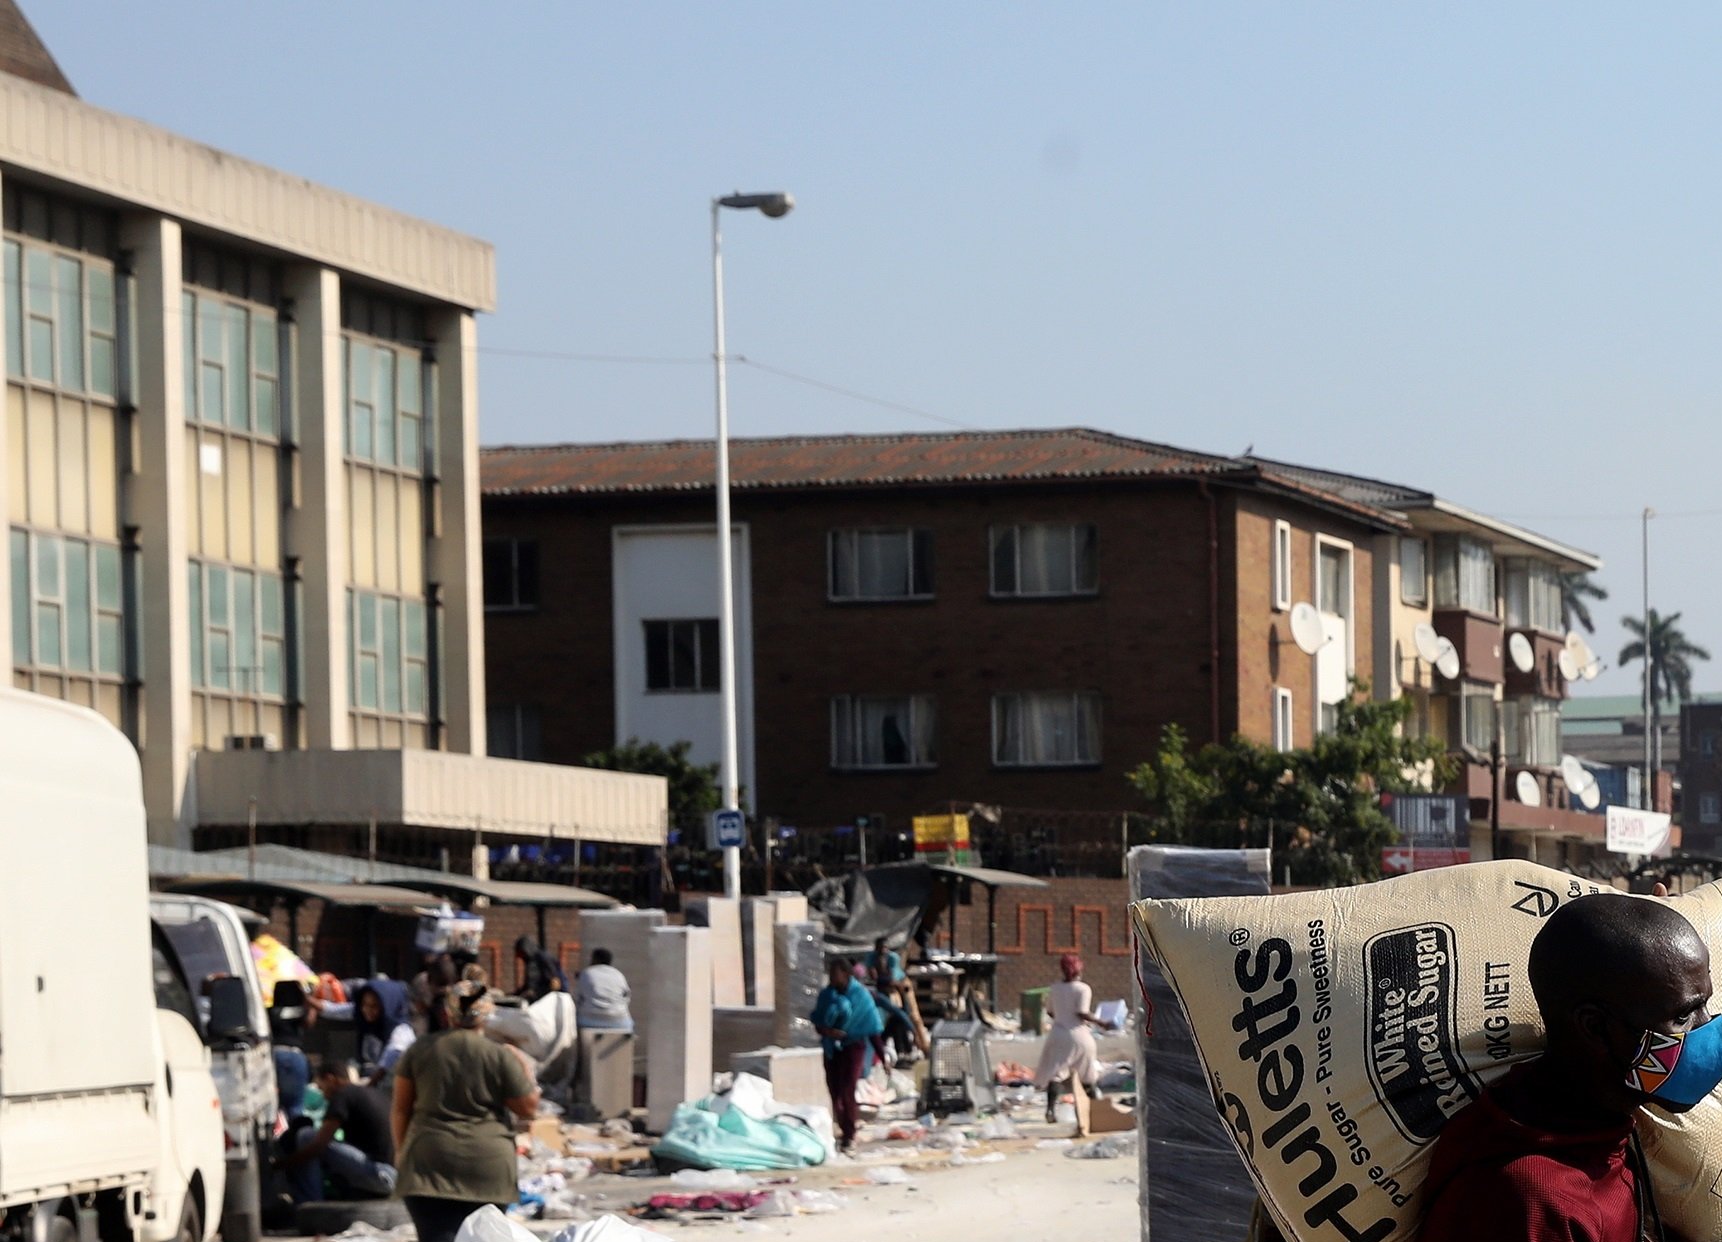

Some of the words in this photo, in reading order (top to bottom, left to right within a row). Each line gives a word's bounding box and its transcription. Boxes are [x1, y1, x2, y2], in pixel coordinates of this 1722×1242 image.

[1307, 919, 1332, 1024] Sweetness
[1408, 928, 1447, 1008] Sugar
[1484, 961, 1511, 1010] NETT
[1313, 1026, 1333, 1083] Pure
[1407, 1014, 1473, 1119] Reined
[1484, 1015, 1512, 1061] 0KG
[1328, 1100, 1371, 1166] Sugar
[1370, 1165, 1413, 1207] Pure
